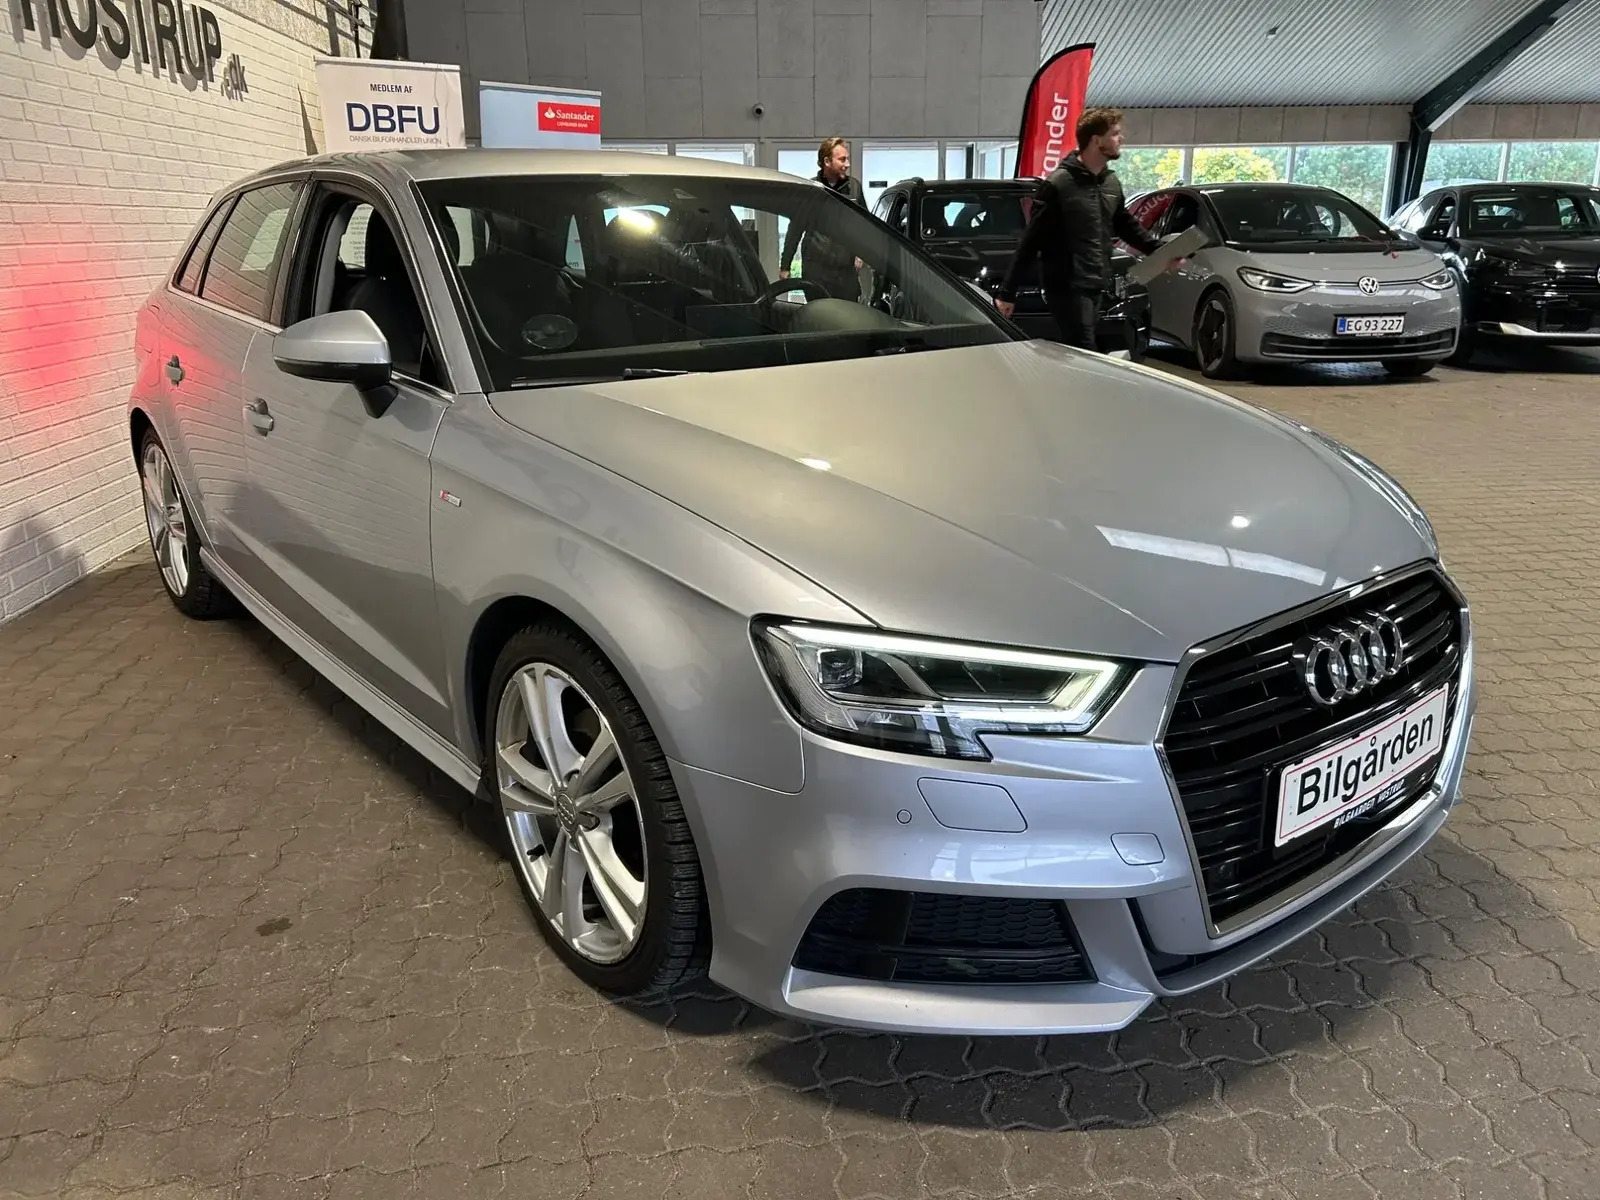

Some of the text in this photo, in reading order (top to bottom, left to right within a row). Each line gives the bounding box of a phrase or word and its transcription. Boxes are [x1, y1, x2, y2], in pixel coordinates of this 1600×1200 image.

[370, 84, 413, 93] MEDLEM AF
[346, 102, 440, 134] DBFU
[556, 109, 595, 121] Santander
[1346, 319, 1402, 332] EG 93 227
[1297, 713, 1433, 816] Bilgården
